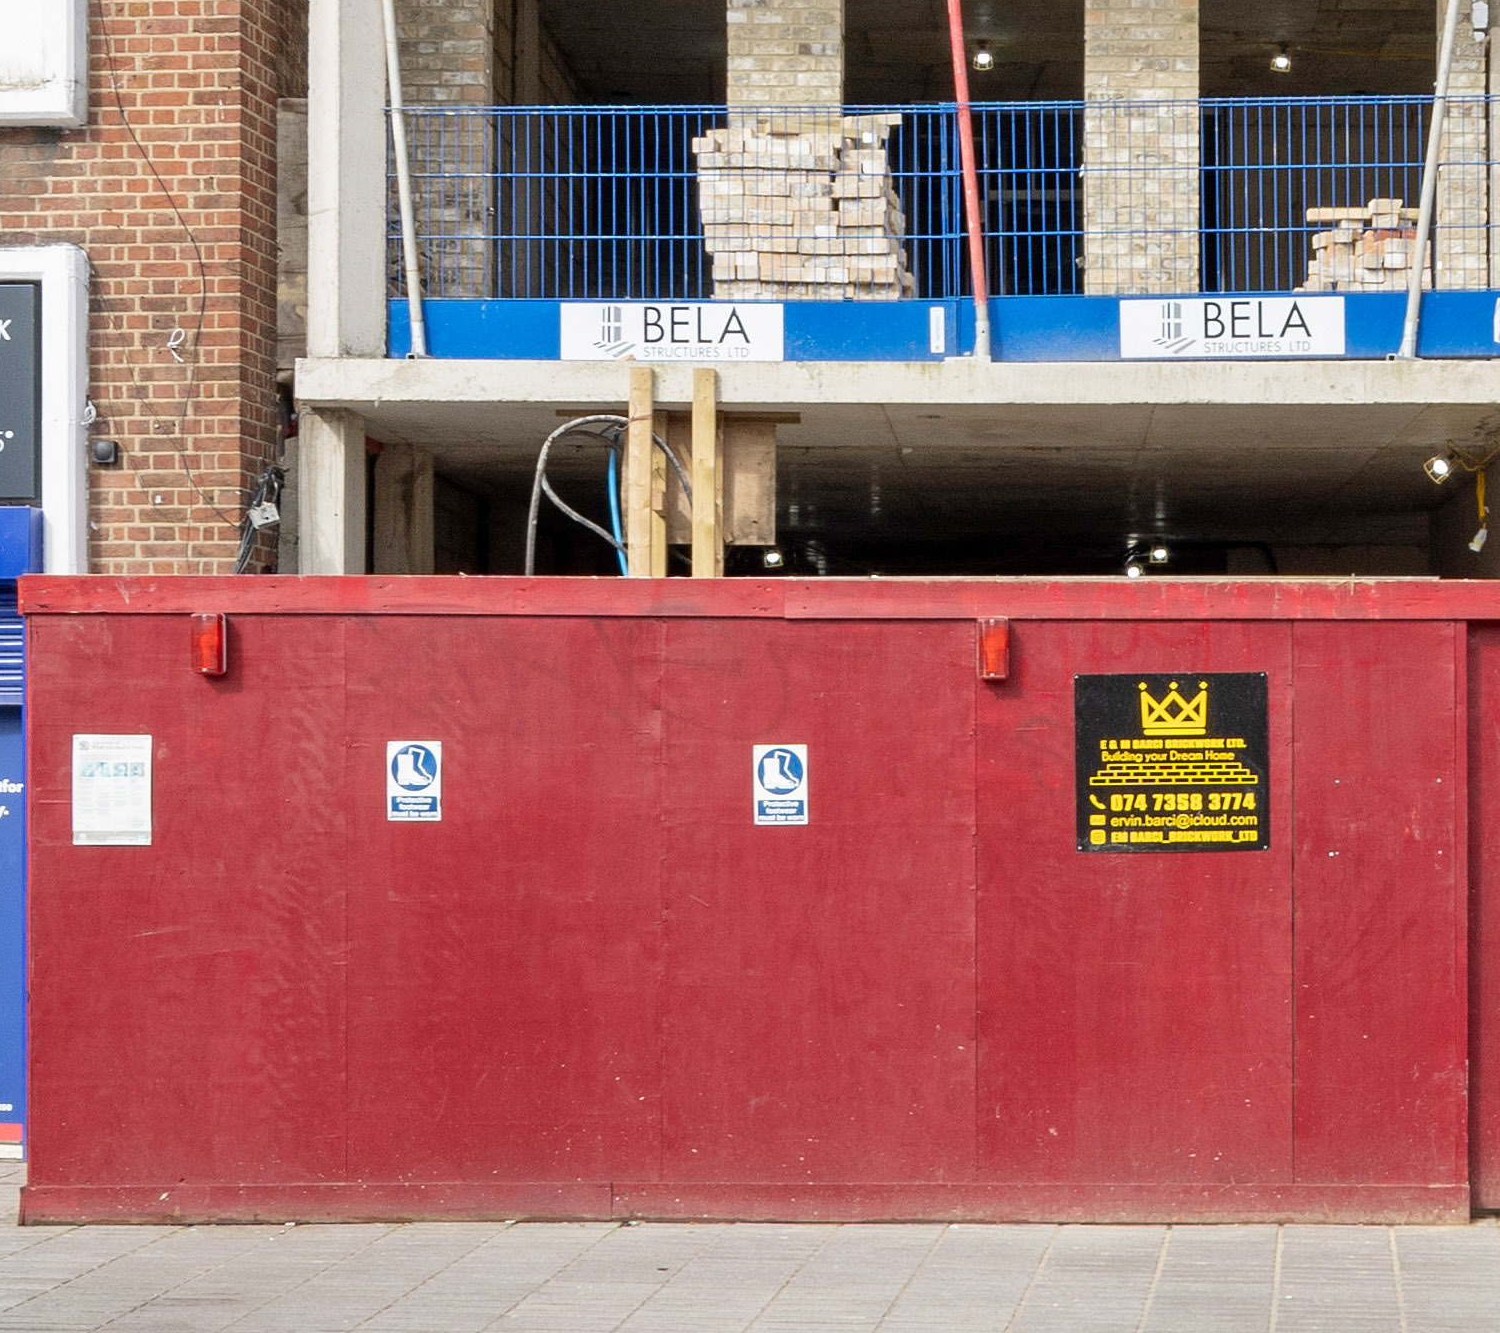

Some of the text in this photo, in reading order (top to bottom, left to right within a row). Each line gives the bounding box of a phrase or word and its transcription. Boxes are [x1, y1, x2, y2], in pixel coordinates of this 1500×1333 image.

[644, 307, 749, 343] BELA
[1204, 301, 1311, 338] BELA
[1102, 750, 1235, 762] Building your Dream Home
[1111, 793, 1256, 811] 074 7358 3774
[1110, 814, 1258, 829] ervin.barci@icloud.com
